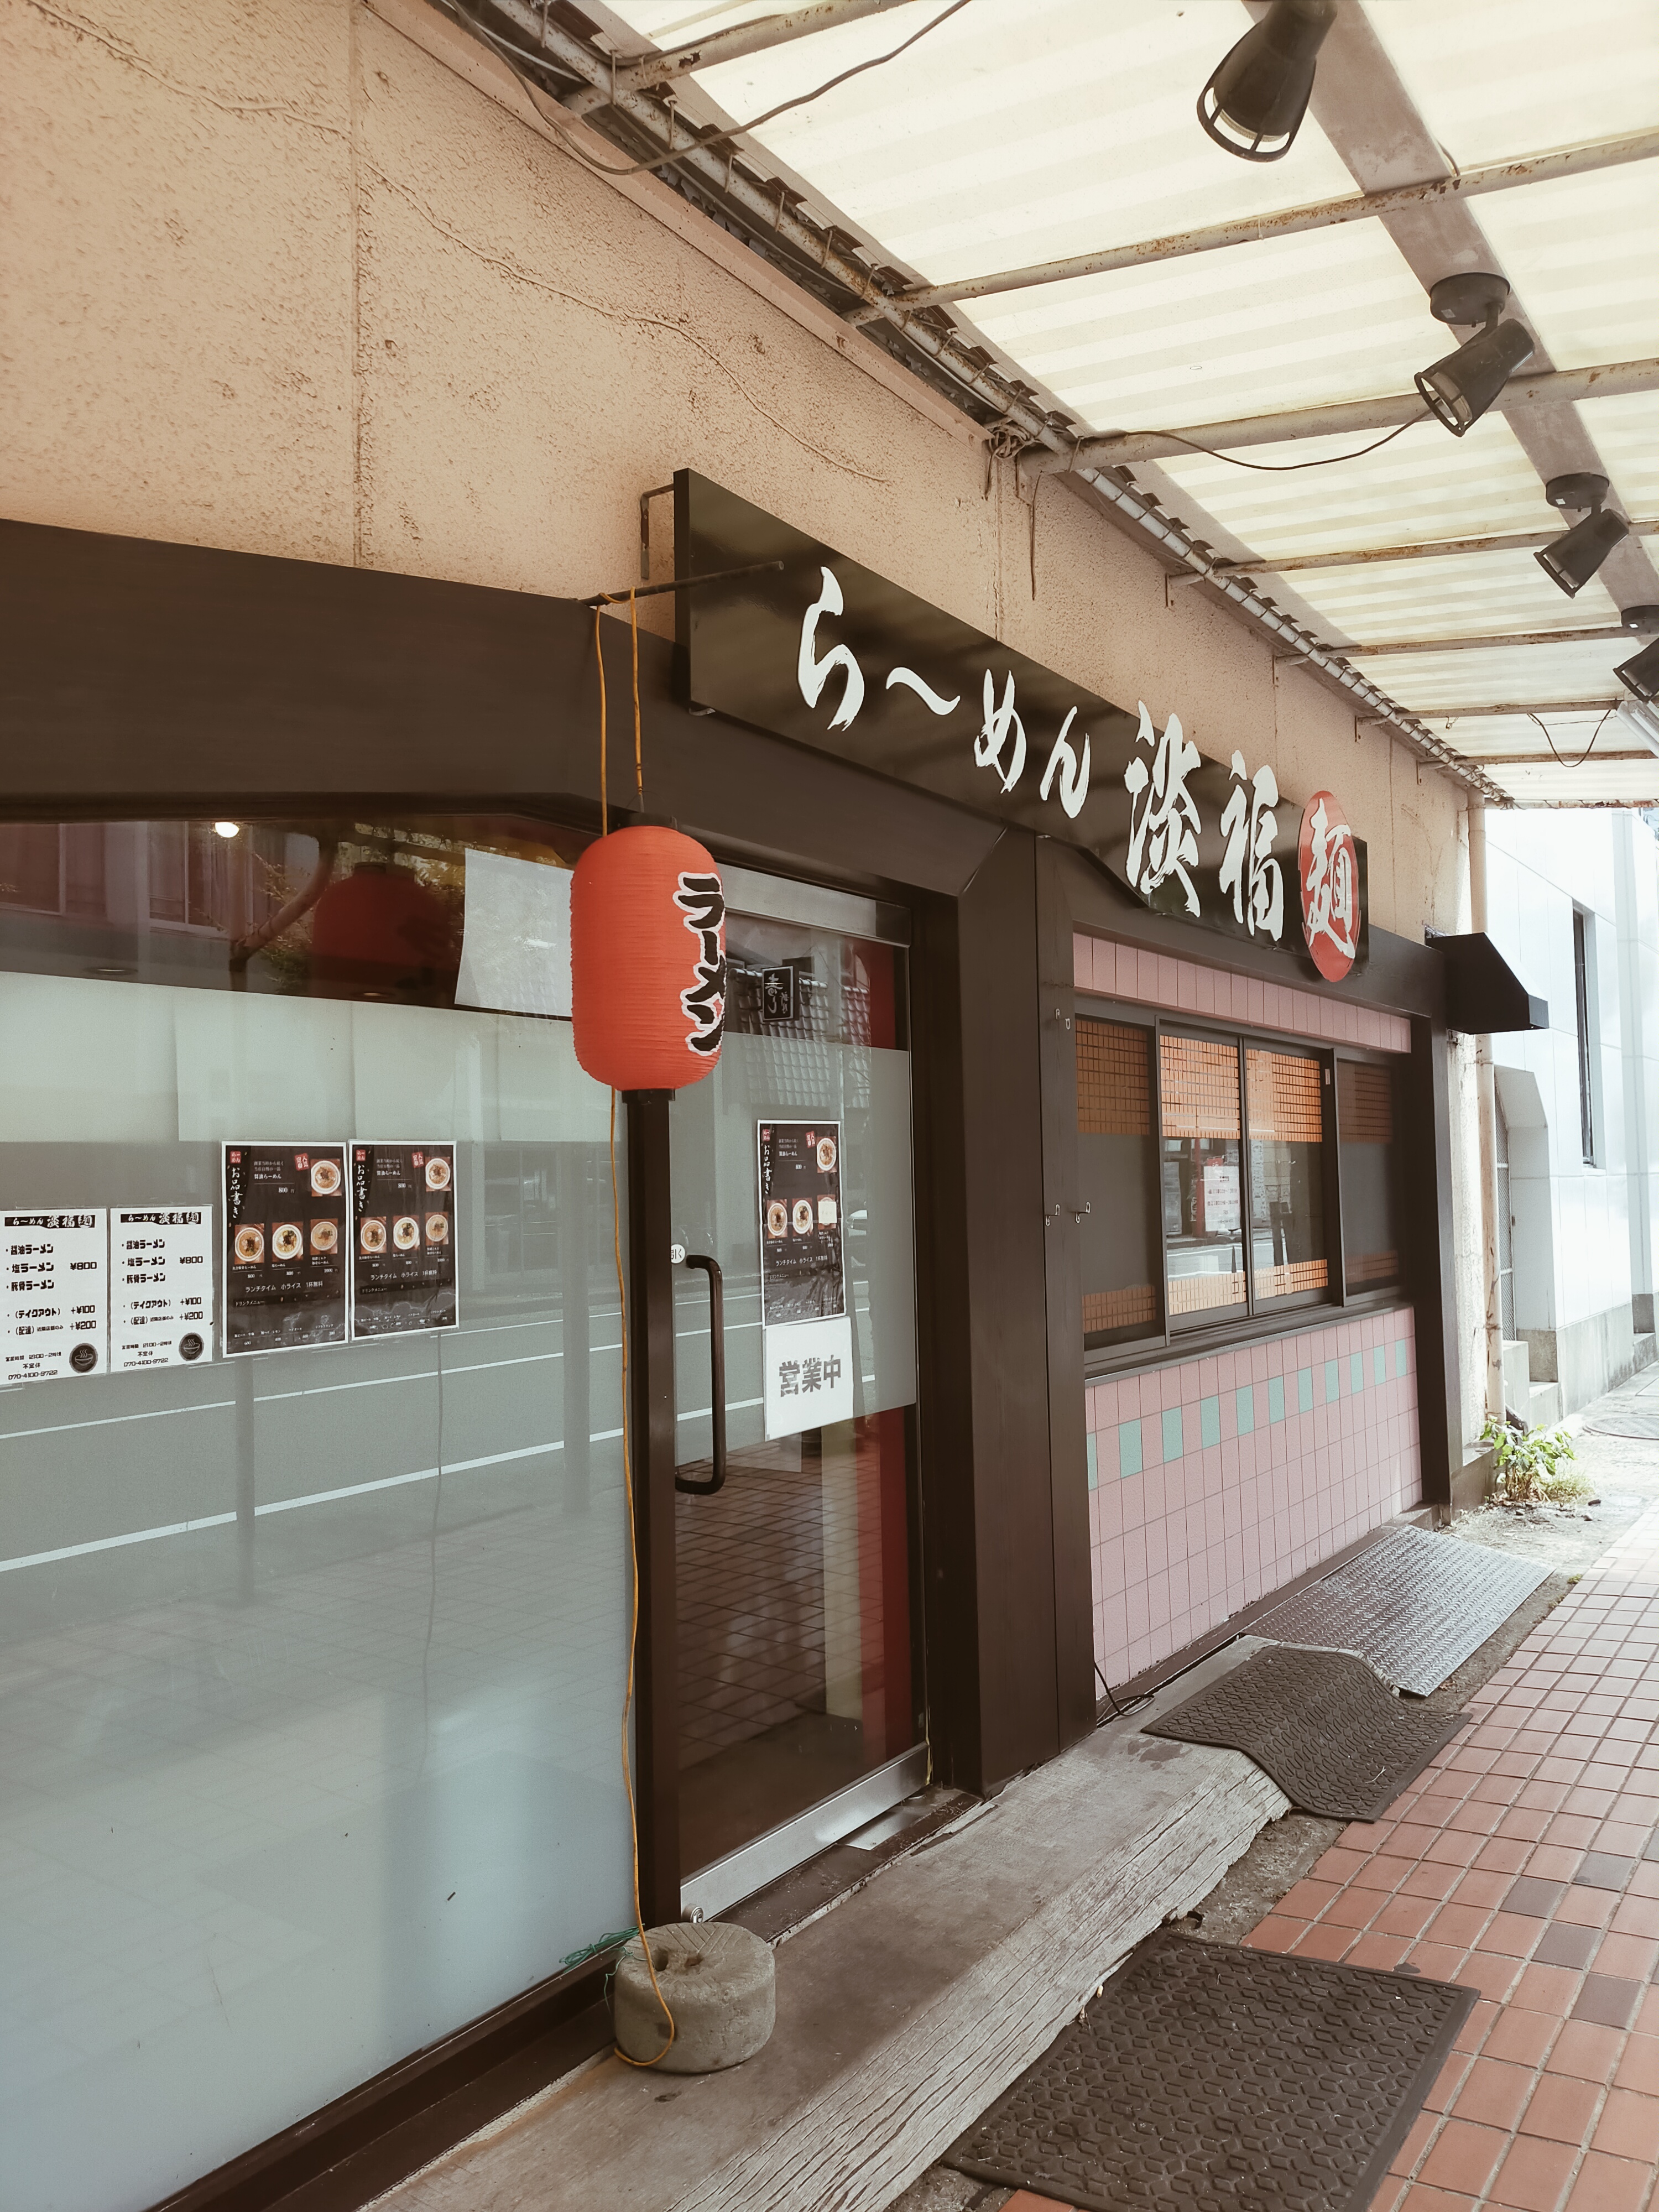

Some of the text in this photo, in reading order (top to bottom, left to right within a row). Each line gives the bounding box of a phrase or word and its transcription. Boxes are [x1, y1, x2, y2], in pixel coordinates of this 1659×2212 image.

[672, 872, 727, 1056] ラーメン
[764, 1145, 773, 1194] お品書き
[230, 1167, 243, 1218] お品書き
[356, 1165, 367, 1212] お品書き
[11, 1244, 54, 1255] 醤油ラーメン
[126, 1239, 165, 1250] 醤油ラーメン
[127, 1256, 204, 1267] 塩ラーメン ¥800
[12, 1261, 97, 1274] 塩ラーメン ¥800
[127, 1272, 166, 1284] 豚骨ラーメン
[11, 1280, 54, 1291] 豚骨ラーメン
[246, 1284, 276, 1293] ランチタイム
[15, 1308, 60, 1318] (テイクアウト)
[124, 1358, 169, 1367] 070-4100-9722
[8, 1370, 58, 1380] 070-4100-9722
[779, 1354, 841, 1397] 営業中
